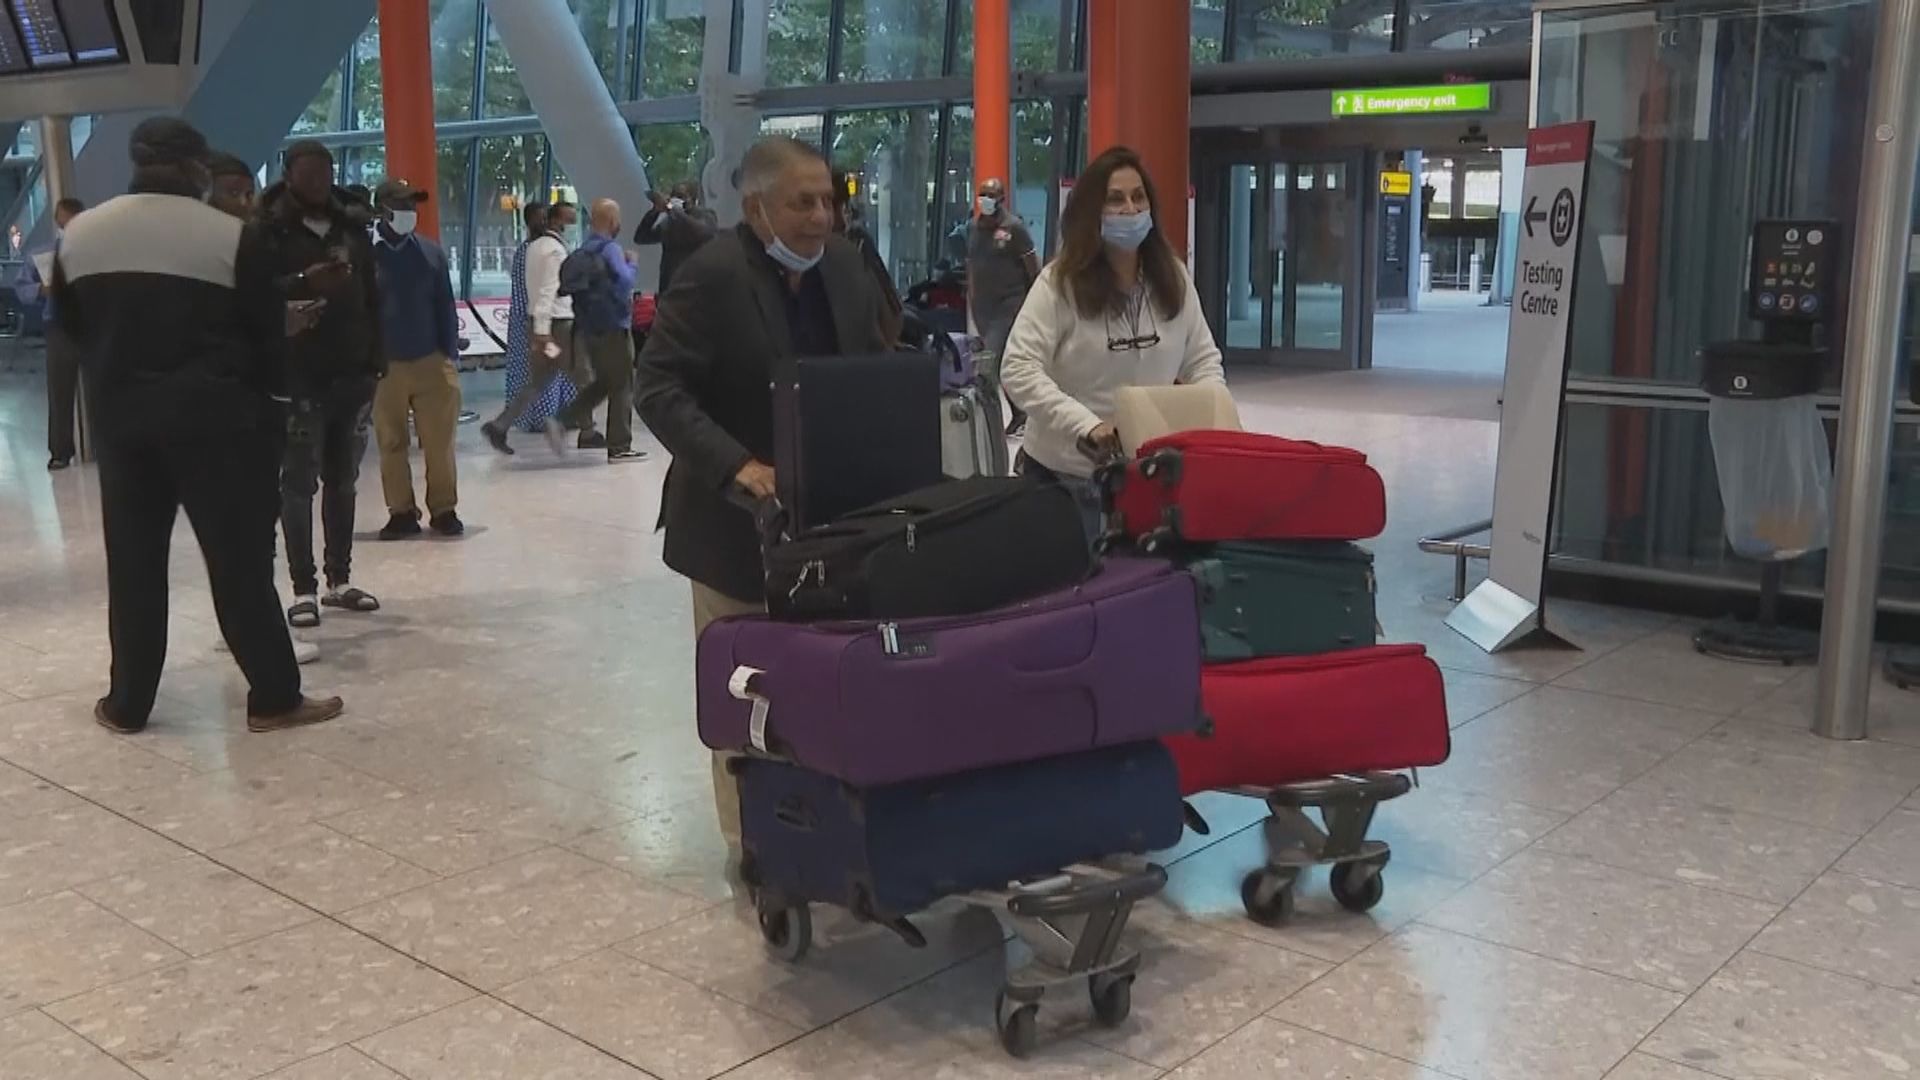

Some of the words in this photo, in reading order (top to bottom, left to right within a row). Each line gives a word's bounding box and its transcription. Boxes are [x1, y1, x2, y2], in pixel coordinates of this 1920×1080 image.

[1368, 97, 1431, 111] Emergency
[1433, 94, 1457, 107] exit
[1522, 260, 1563, 291] Testing
[1520, 289, 1558, 317] Centre
